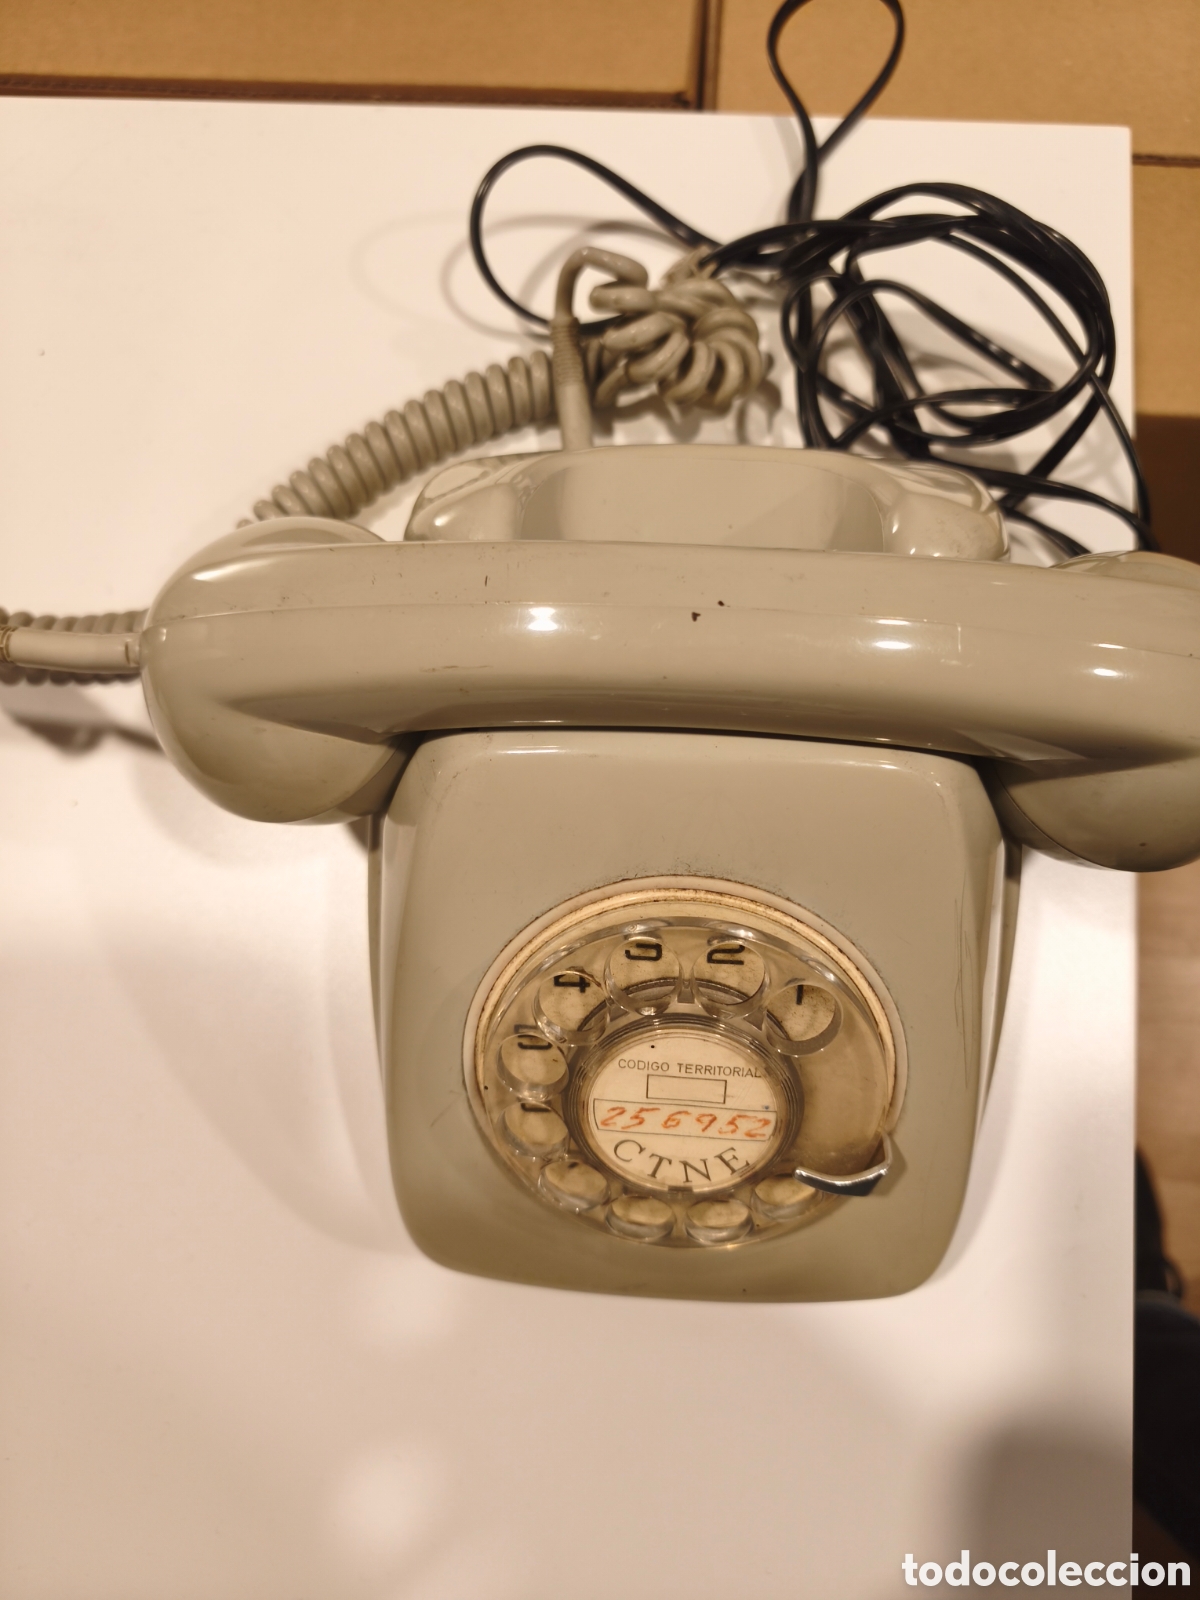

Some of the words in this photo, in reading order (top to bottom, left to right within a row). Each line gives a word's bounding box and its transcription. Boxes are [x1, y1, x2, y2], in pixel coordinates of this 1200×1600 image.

[617, 1058, 670, 1072] CODIGO
[676, 1062, 763, 1079] TERRITORIAL
[613, 1138, 751, 1184] CTNE
